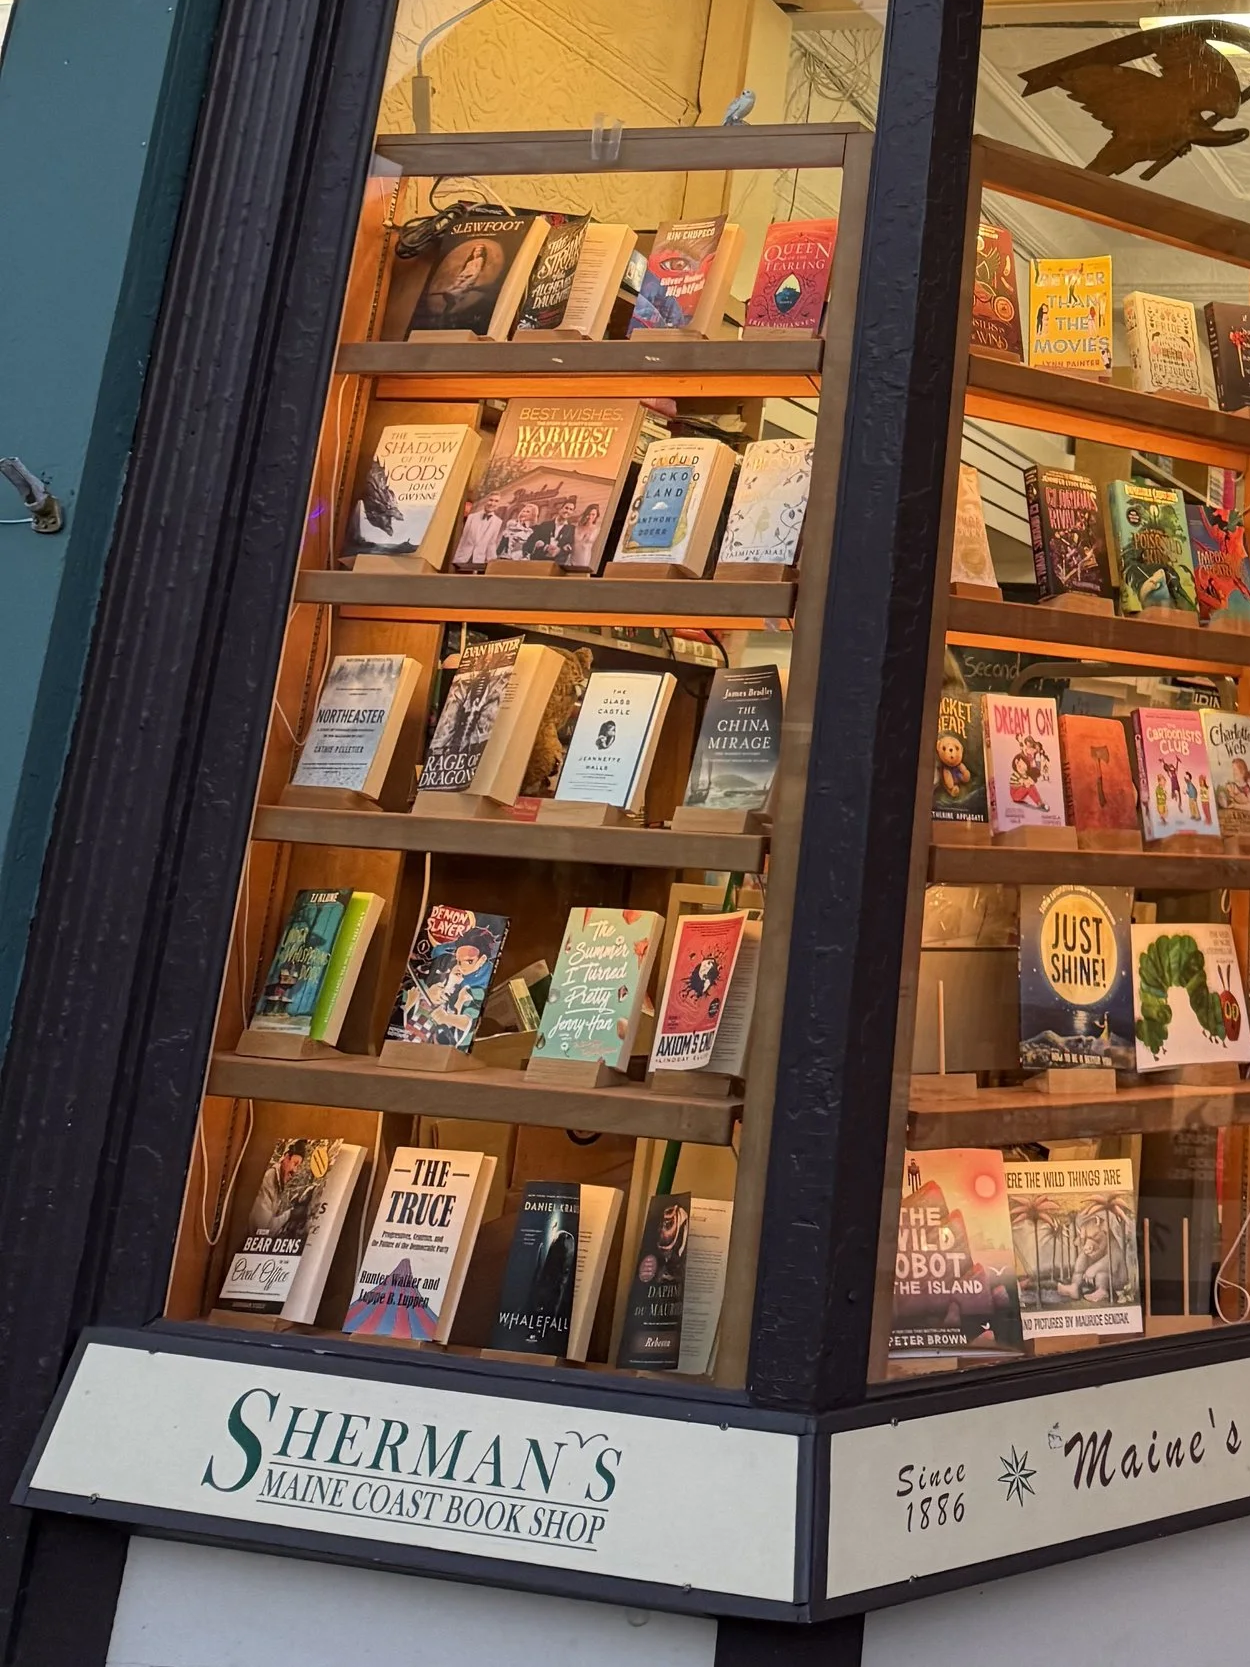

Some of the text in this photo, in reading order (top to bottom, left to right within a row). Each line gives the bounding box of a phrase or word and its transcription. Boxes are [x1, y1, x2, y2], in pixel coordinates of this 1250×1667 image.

[451, 220, 525, 235] SLEWFOOT
[666, 227, 716, 241] RIN CHUPECO
[763, 242, 833, 263] QUEEN
[764, 259, 827, 272] TEARLING
[1046, 294, 1099, 309] THAN
[1055, 317, 1089, 331] THE
[1034, 336, 1110, 354] MOVIES
[519, 407, 560, 422] BEST
[391, 432, 409, 440] THE
[517, 425, 619, 444] WARMEST
[383, 441, 458, 458] SHADOW
[514, 441, 610, 459] REGARDS
[418, 455, 435, 463] THE
[651, 453, 700, 468] CLOUD
[390, 464, 448, 482] GODS
[642, 472, 700, 484] CUCKOO
[408, 483, 436, 492] JOHN
[645, 488, 684, 498] LAND
[397, 492, 438, 502] GWYNNE
[463, 645, 486, 659] EVAN
[963, 652, 1021, 680] Second
[723, 687, 773, 700] James Bradley
[316, 708, 386, 725] NORTHEASTER
[598, 708, 631, 716] CASTLE
[737, 706, 756, 715] THE
[994, 703, 1054, 736] DREAM ON
[717, 719, 770, 732] CHINA
[708, 736, 772, 750] MIRAGE
[1146, 725, 1203, 745] CARTOONISTS
[1159, 740, 1190, 756] CLUB
[1225, 738, 1247, 758] Web
[425, 754, 467, 773] RAGE
[431, 904, 469, 926] DEMON
[426, 917, 465, 938] SLAYER
[588, 919, 617, 942] The
[1051, 911, 1103, 956] JUST
[568, 941, 630, 966] Summer
[565, 962, 628, 986] I Turned
[1051, 953, 1106, 988] SHINE!
[564, 985, 616, 1012] Pretty
[548, 1013, 614, 1040] Jenny Han
[656, 1029, 698, 1057] AXIOM'S
[411, 1158, 451, 1188] THE
[1024, 1168, 1122, 1189] THE WILD THINGS ARE
[385, 1190, 456, 1228] TRUCE
[524, 1201, 558, 1213] DANIEL
[243, 1236, 301, 1254] BEAR DENS
[258, 1259, 291, 1291] Office
[359, 1269, 441, 1291] Hunter Walker and
[928, 1280, 983, 1295] ISLAND
[499, 1312, 569, 1337] WHALEFALL
[1034, 1312, 1130, 1330] PICTURES BY MAURICE SENDAK
[888, 1334, 968, 1347] PETER BROWN
[201, 1387, 623, 1503] SHERMAN'S
[1062, 1403, 1243, 1492] Maine's
[895, 1459, 967, 1500] Since
[259, 1467, 606, 1545] MAINE COAST BOOK SHOP
[905, 1492, 967, 1533] 1886
